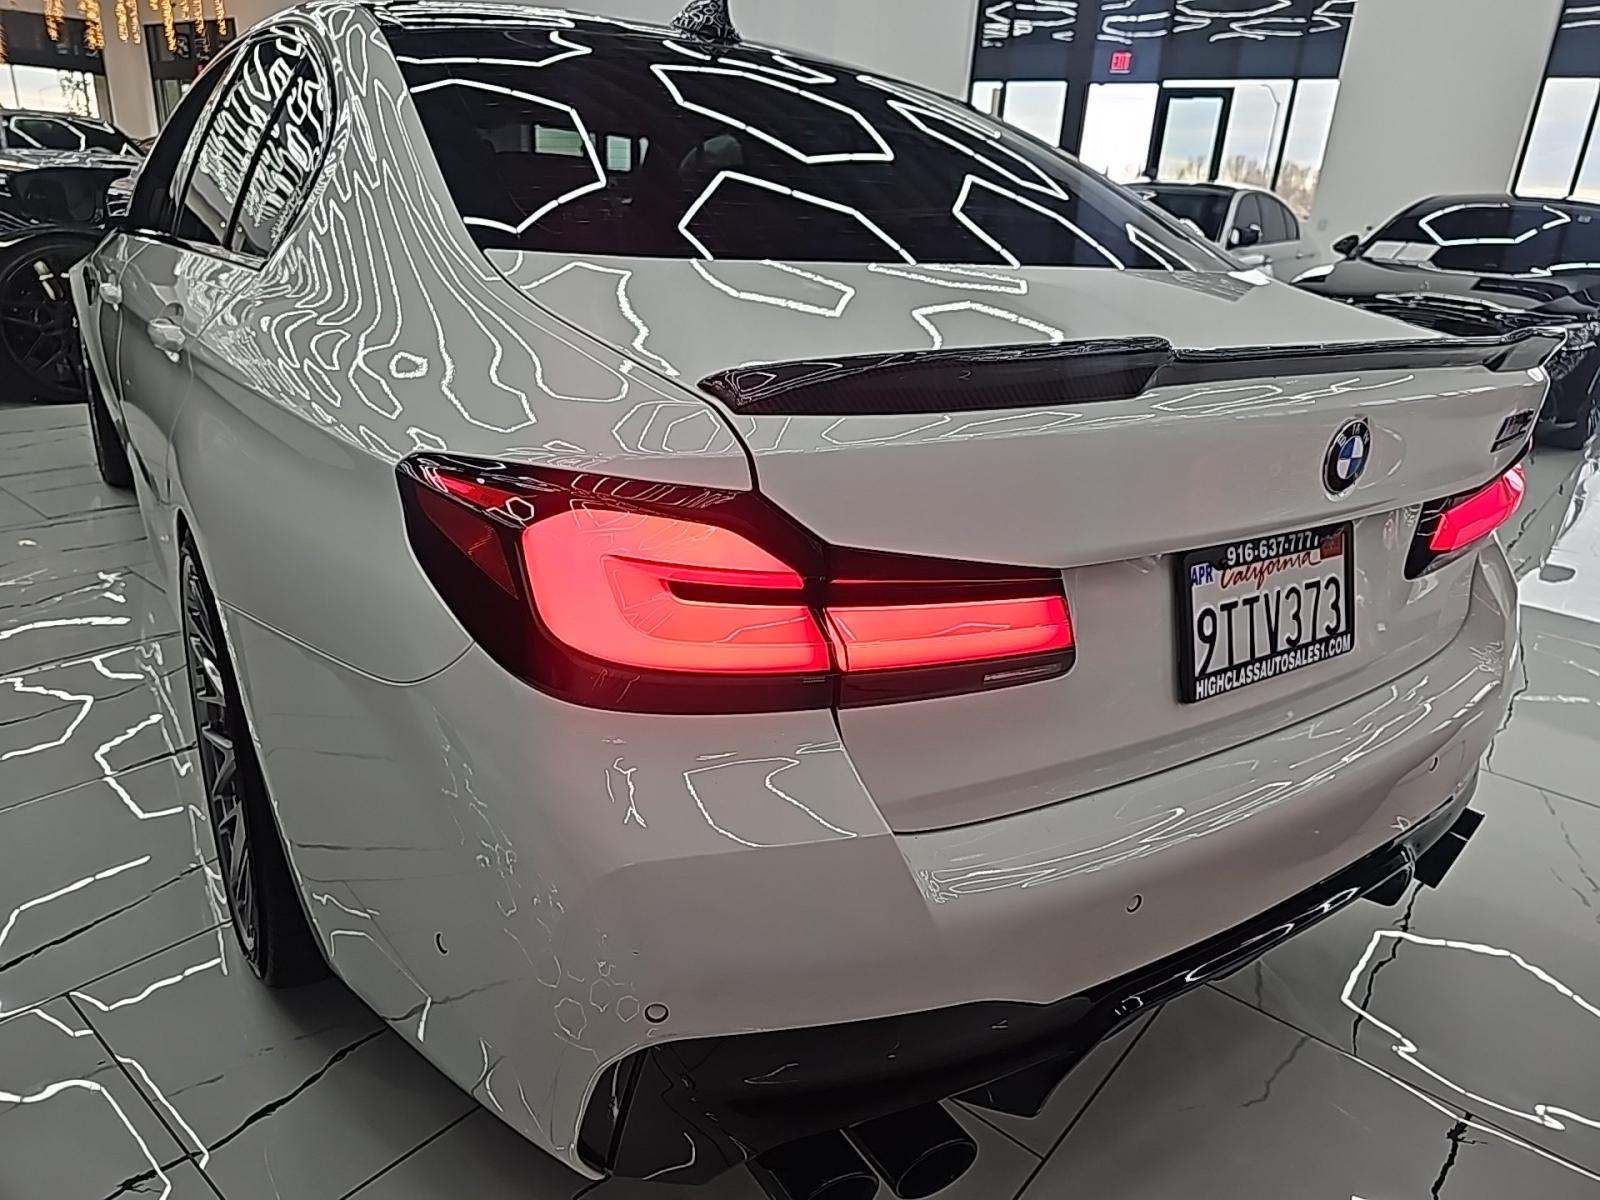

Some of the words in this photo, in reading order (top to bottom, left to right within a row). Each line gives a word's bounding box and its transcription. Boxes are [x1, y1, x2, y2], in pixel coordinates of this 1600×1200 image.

[1191, 564, 1214, 586] APR
[1220, 551, 1322, 591] California
[1197, 576, 1342, 677] 9TTV373
[1195, 633, 1351, 701] HIGHCLASSAUTOSALES1.COM
